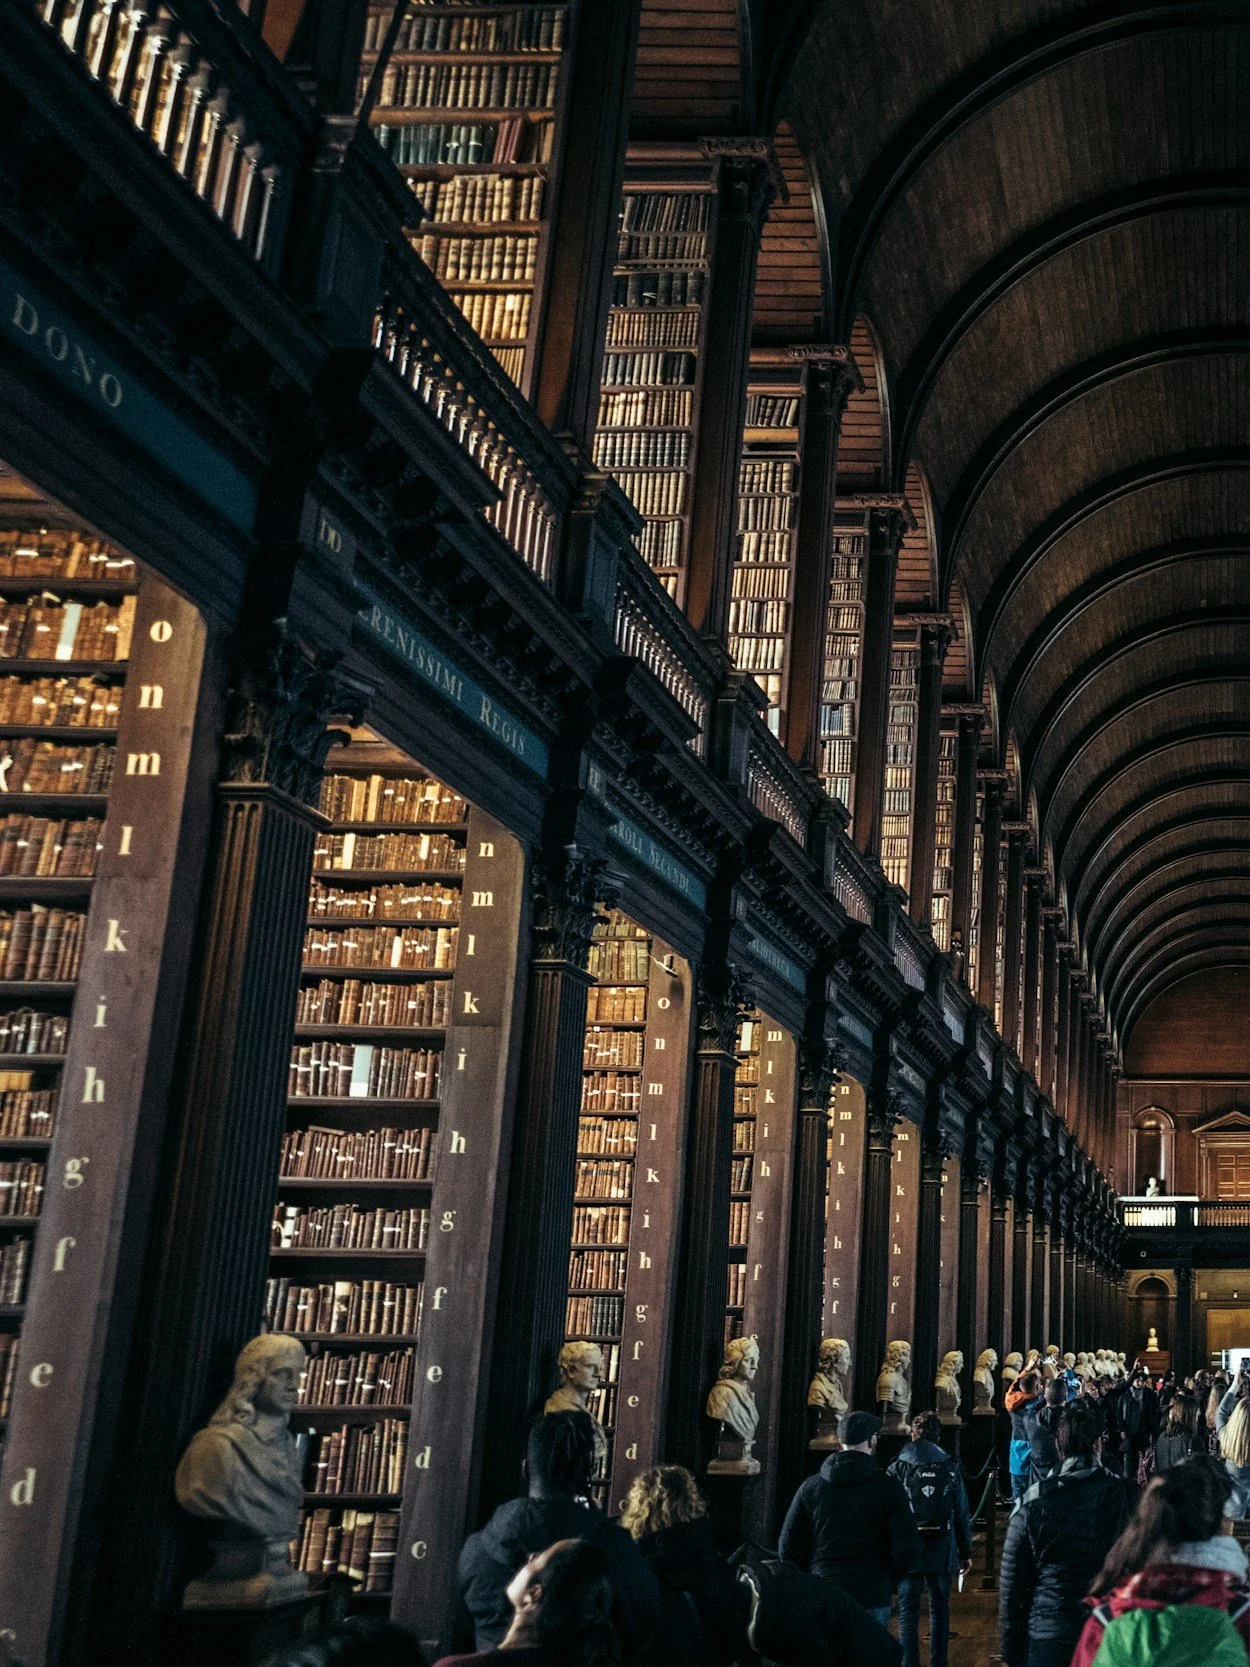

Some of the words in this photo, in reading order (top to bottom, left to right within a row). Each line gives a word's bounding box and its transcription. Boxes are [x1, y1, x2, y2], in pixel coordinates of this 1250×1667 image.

[12, 293, 122, 408] DONO
[150, 621, 172, 642] o
[139, 685, 163, 708] n
[126, 753, 160, 775] m
[119, 826, 132, 855] l
[479, 843, 493, 857] n
[472, 892, 493, 906] m
[104, 920, 126, 951] k
[467, 935, 475, 955] l
[464, 992, 479, 1013] k
[658, 998, 670, 1009] o
[94, 996, 106, 1027] i
[655, 1038, 665, 1049] n
[768, 1031, 782, 1041] m
[457, 1048, 466, 1070] i
[82, 1067, 104, 1102] h
[649, 1083, 663, 1094] m
[841, 1086, 849, 1094] n
[765, 1089, 775, 1103] k
[840, 1112, 851, 1120] m
[450, 1131, 465, 1153] h
[64, 1157, 89, 1188] g
[647, 1168, 659, 1182] k
[761, 1161, 770, 1176] h
[838, 1162, 845, 1174] k
[897, 1185, 904, 1195] k
[440, 1211, 456, 1231] g
[756, 1210, 764, 1223] g
[834, 1236, 841, 1249] h
[894, 1244, 901, 1254] h
[54, 1237, 75, 1271] f
[640, 1252, 651, 1268] h
[754, 1264, 762, 1280] f
[832, 1276, 841, 1289] g
[433, 1287, 447, 1309] f
[636, 1305, 648, 1322] g
[633, 1341, 643, 1359] f
[30, 1364, 53, 1387] e
[427, 1366, 442, 1382] e
[628, 1396, 639, 1407] e
[415, 1446, 431, 1468] d
[626, 1443, 637, 1459] d
[11, 1468, 35, 1505] d
[412, 1541, 426, 1559] c
